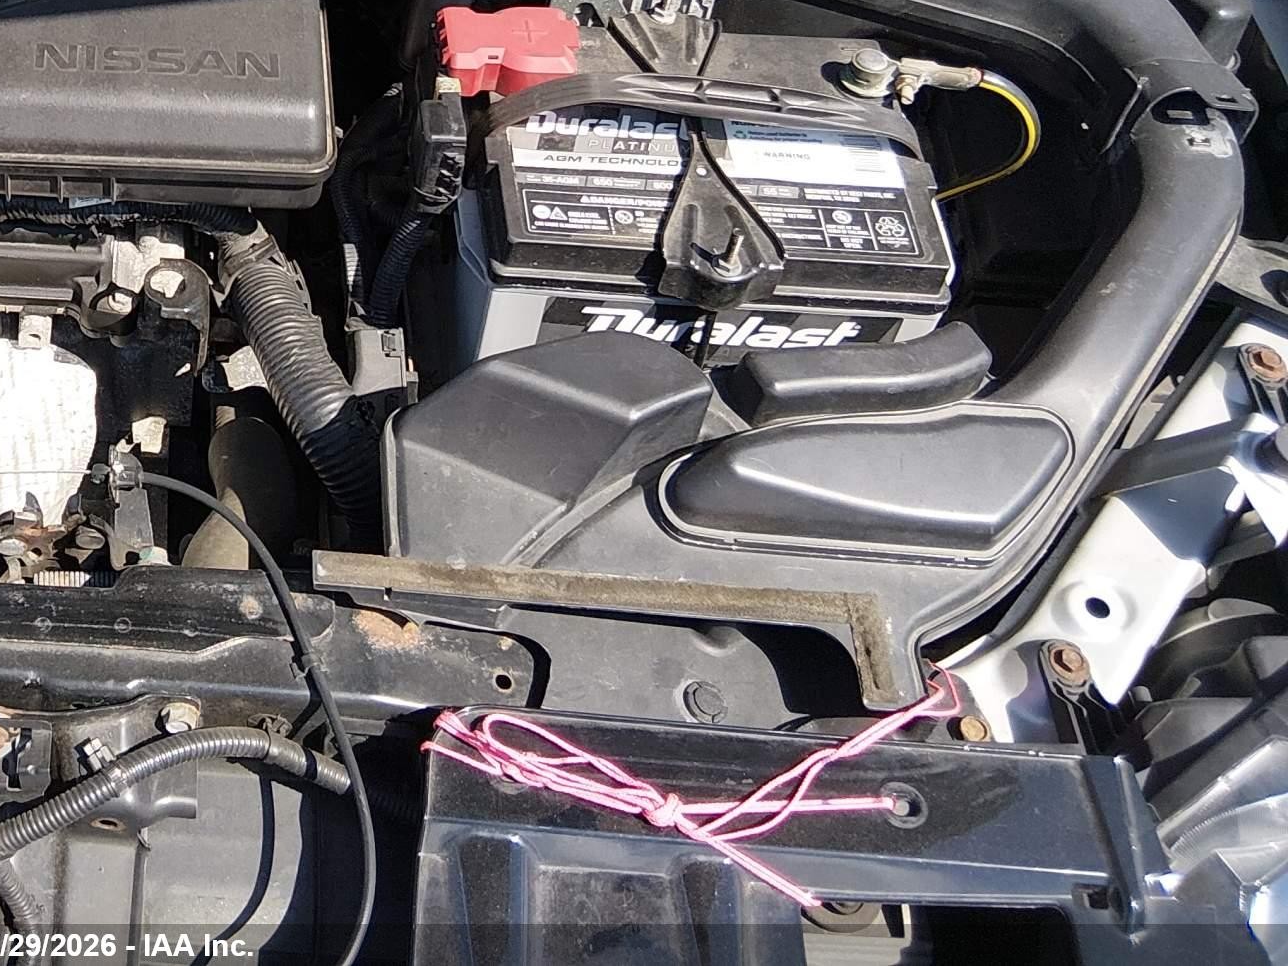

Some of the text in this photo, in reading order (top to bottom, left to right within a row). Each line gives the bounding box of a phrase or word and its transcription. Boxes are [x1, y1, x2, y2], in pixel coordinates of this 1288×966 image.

[34, 42, 281, 79] NISSAN
[543, 154, 583, 163] AGM
[763, 152, 811, 160] WARNING
[581, 306, 861, 349] Duralast
